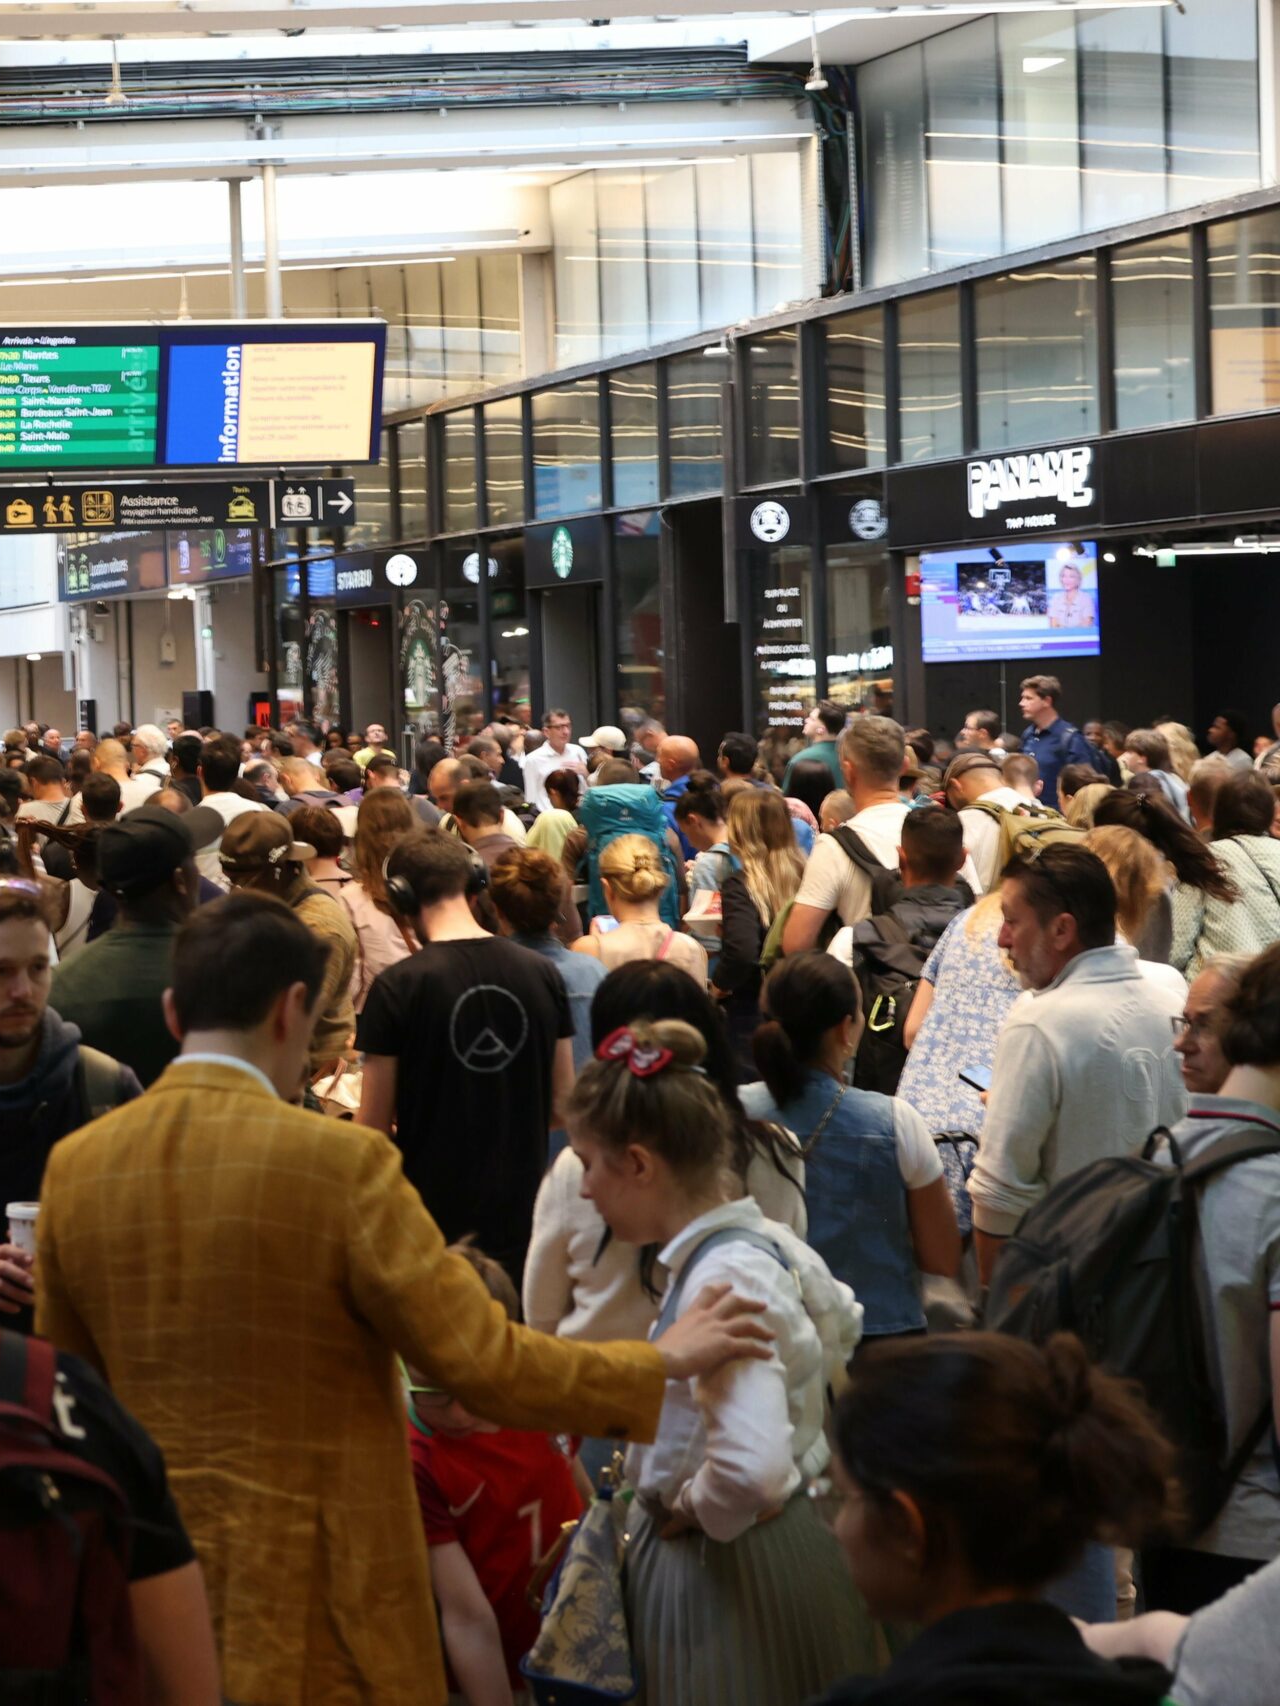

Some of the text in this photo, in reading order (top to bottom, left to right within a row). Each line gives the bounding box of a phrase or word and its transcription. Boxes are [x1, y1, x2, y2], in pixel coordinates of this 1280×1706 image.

[22, 351, 59, 360] Nantes
[22, 374, 51, 384] Tours
[92, 384, 111, 394] TGV
[21, 396, 82, 406] Saint-Nazaire
[218, 346, 241, 462] information
[21, 408, 64, 418] Bordeaux
[64, 407, 113, 417] Saint-Jean
[20, 420, 73, 429] La Rochelle
[20, 431, 70, 441] Saint-Malo
[20, 443, 63, 452] Arcachon
[967, 446, 1093, 518] PANAME
[120, 495, 179, 506] Assistance
[120, 506, 198, 517] voyageur handicapé
[1005, 513, 1057, 529] TAP HOUSE
